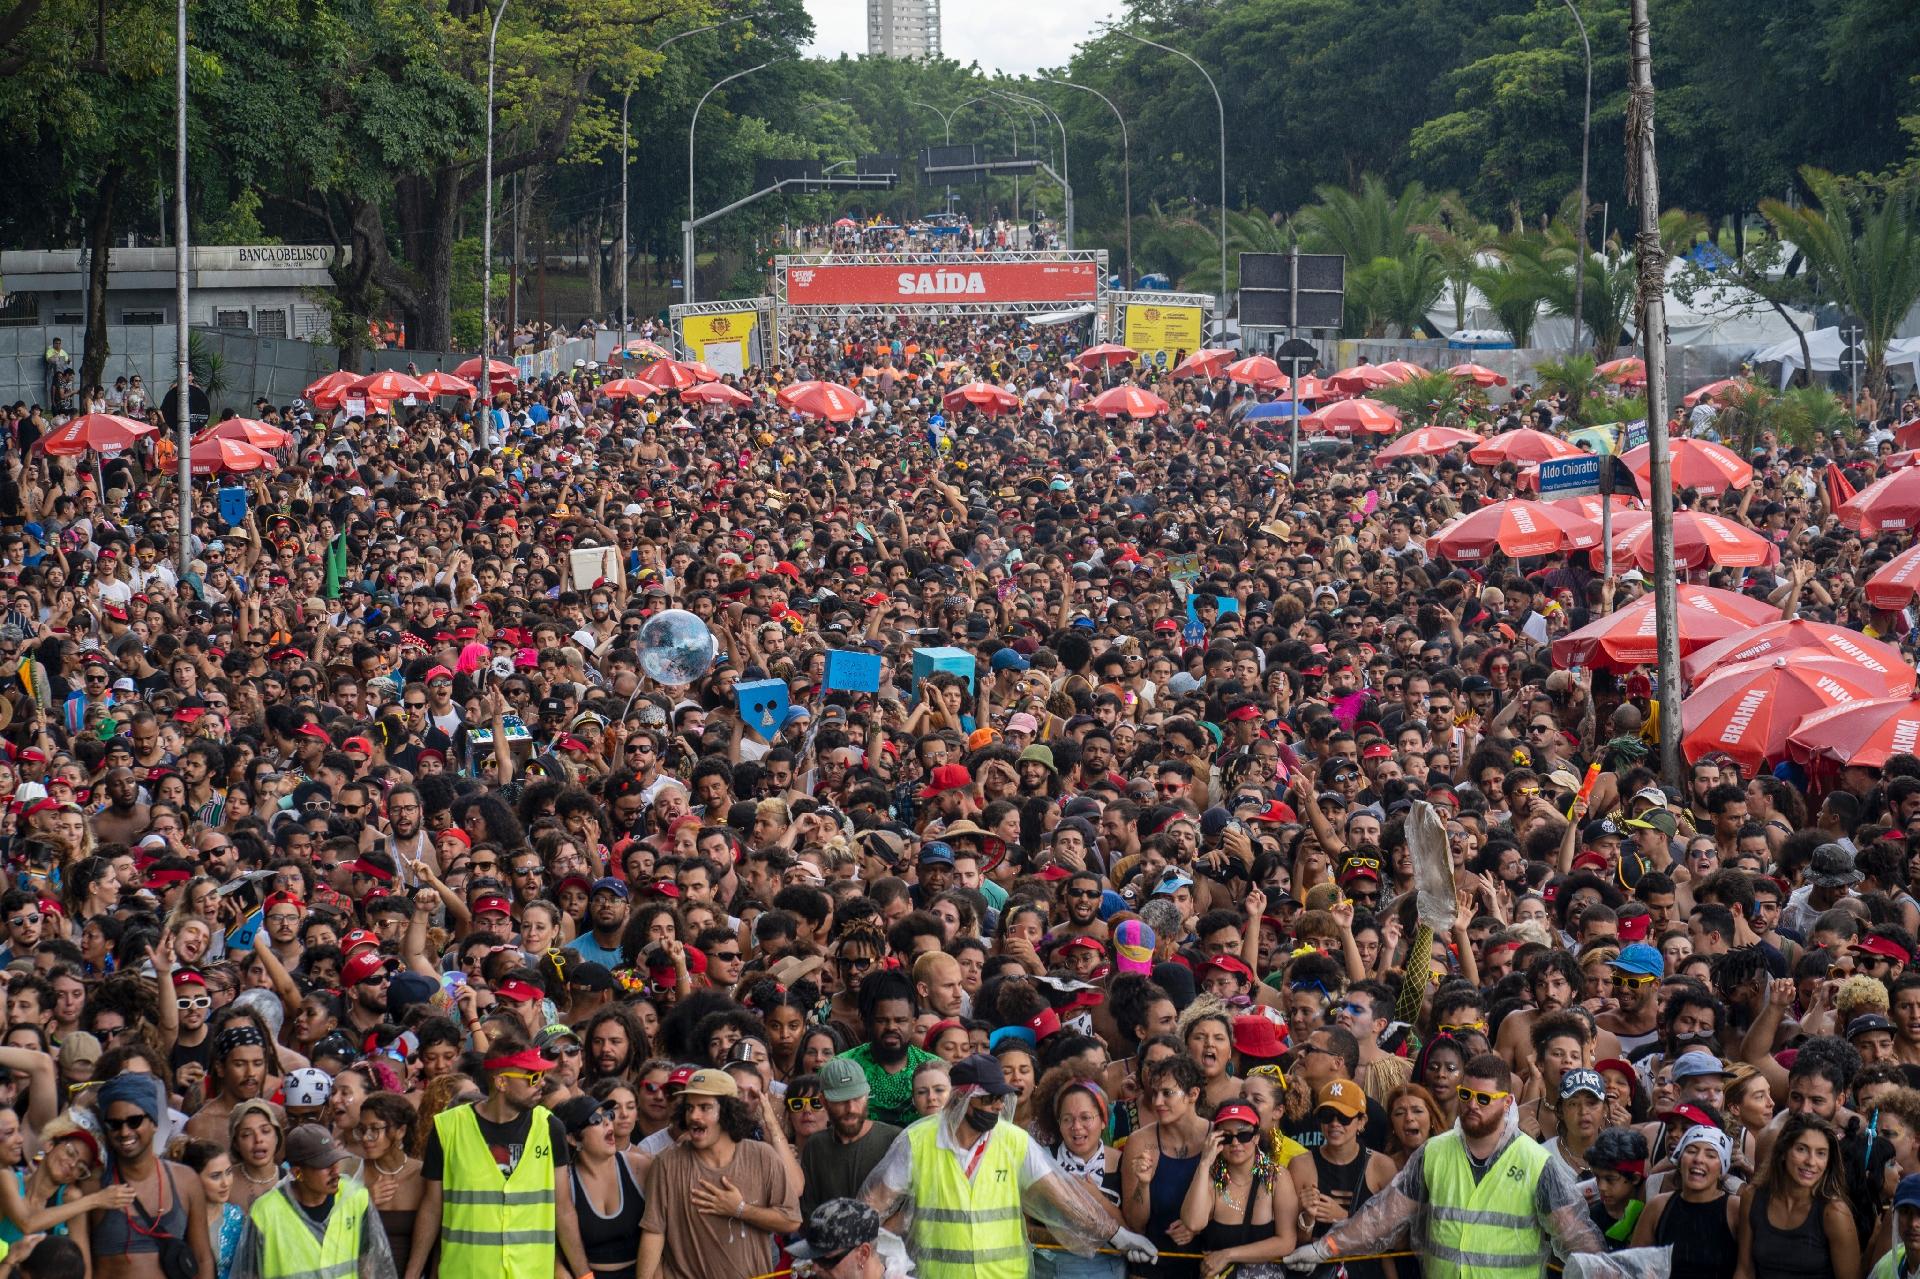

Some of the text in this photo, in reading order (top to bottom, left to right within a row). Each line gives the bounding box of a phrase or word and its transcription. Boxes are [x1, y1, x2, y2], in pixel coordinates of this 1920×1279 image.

[239, 247, 328, 262] BANCA OBELISCO
[897, 268, 986, 295] SAÍDA
[1542, 460, 1598, 480] Aldo Chioratto
[1510, 506, 1537, 534] BRAHMA
[1699, 517, 1741, 543] BRAHMA
[1881, 518, 1906, 528] BRAHMA
[1457, 548, 1481, 558] BRAHMA
[1735, 640, 1772, 660] BRAHMA
[1826, 634, 1889, 673] BRAHMA
[1719, 689, 1769, 745] BRAHMA
[535, 1145, 549, 1159] 94
[995, 1169, 1008, 1182] 77
